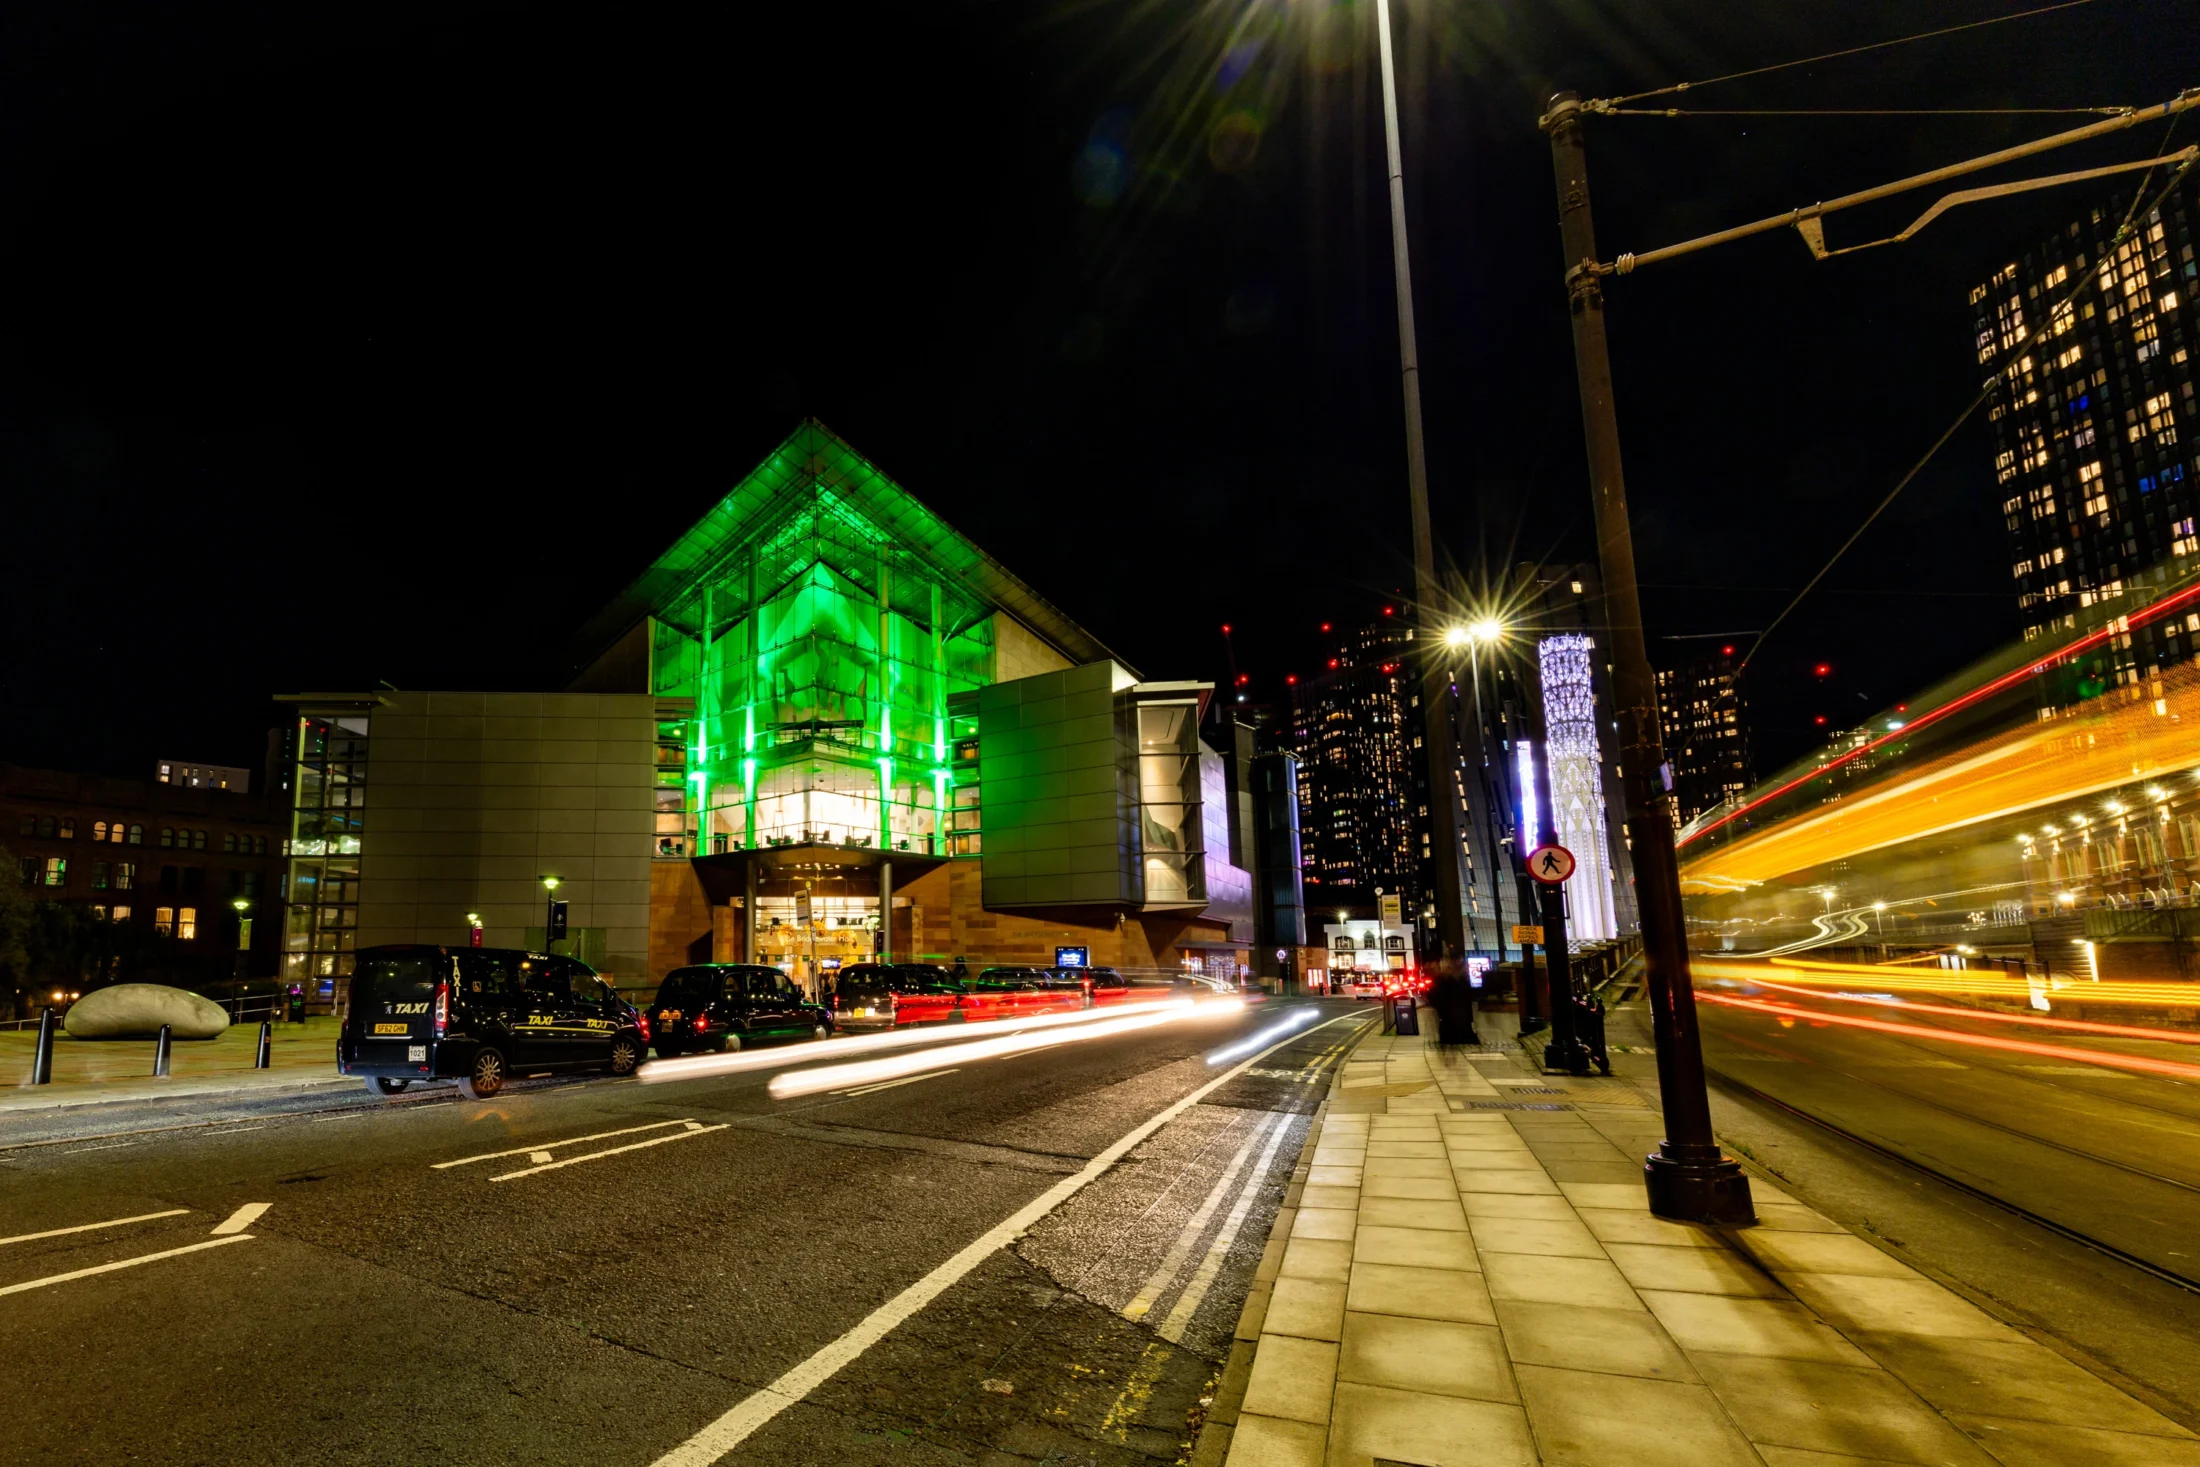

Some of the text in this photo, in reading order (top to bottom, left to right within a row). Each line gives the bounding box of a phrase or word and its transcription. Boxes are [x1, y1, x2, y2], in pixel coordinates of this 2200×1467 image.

[451, 956, 461, 997] TAXI
[395, 1002, 430, 1014] TAXI
[527, 1015, 554, 1026] TAXI
[586, 1018, 608, 1030] TAXI
[410, 1049, 424, 1057] 1021
